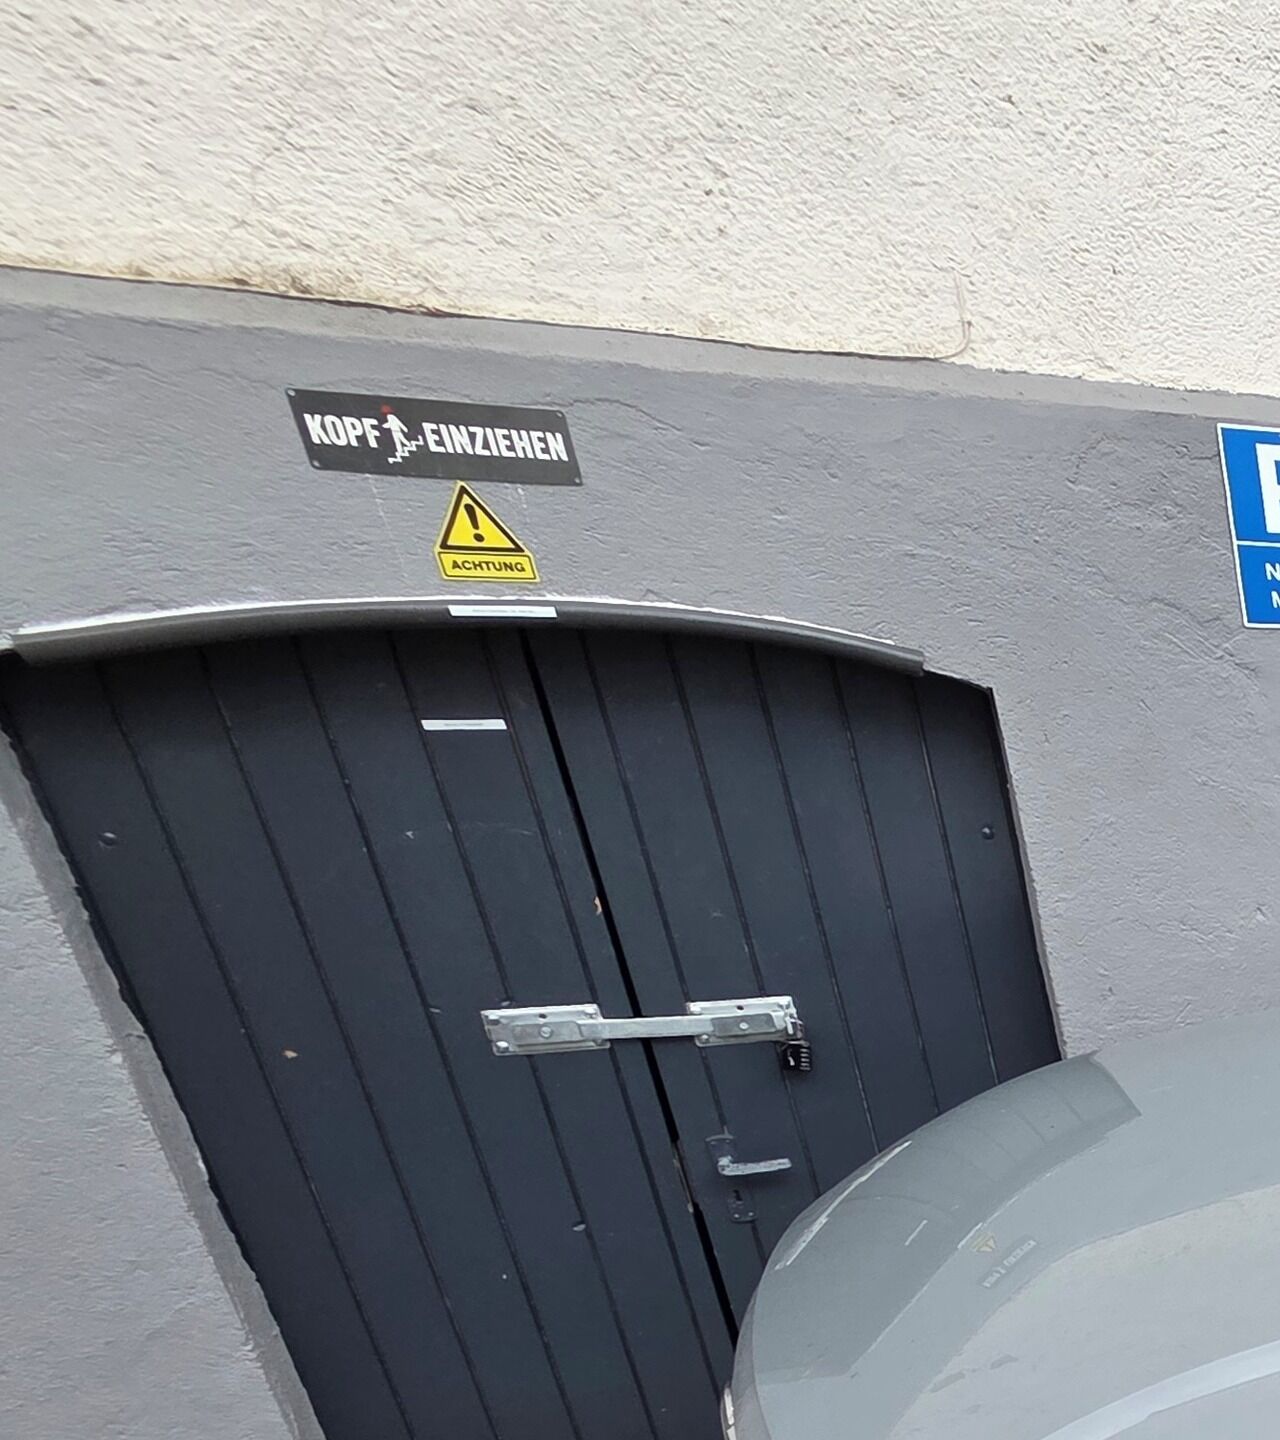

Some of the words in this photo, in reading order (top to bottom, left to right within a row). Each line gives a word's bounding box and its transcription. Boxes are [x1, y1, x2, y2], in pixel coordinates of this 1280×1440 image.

[303, 413, 380, 448] KOPF
[422, 422, 569, 462] EINZIEHEN
[451, 559, 526, 573] ACHTUNG
